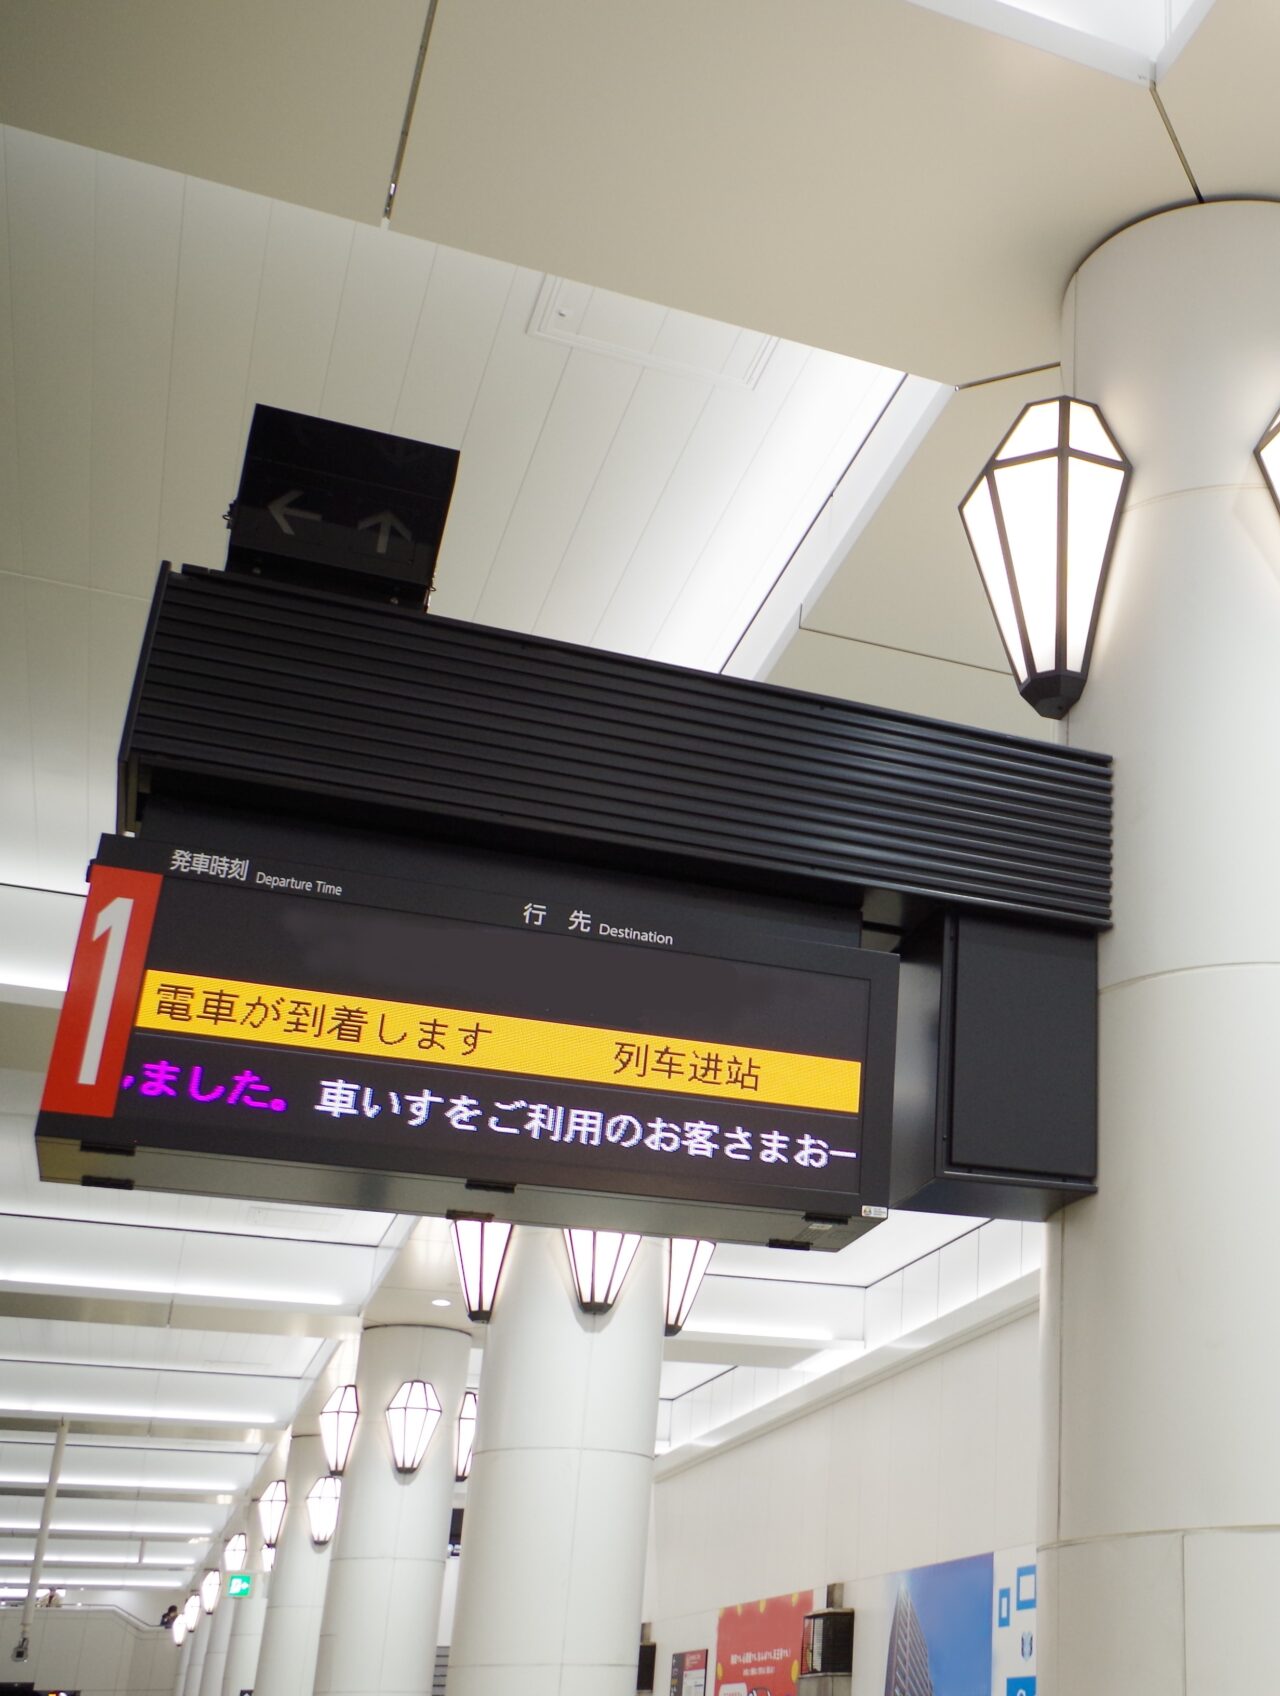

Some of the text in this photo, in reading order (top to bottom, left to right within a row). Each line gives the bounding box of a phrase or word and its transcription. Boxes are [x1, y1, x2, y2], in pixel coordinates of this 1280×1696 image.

[171, 849, 249, 881] 発車時刻
[255, 872, 343, 896] Departure Time
[599, 923, 673, 946] Destination
[77, 896, 134, 1085] 1
[156, 983, 492, 1056] 電車が到着します
[122, 1060, 287, 1112] ました。
[613, 1041, 762, 1091] 列车进站
